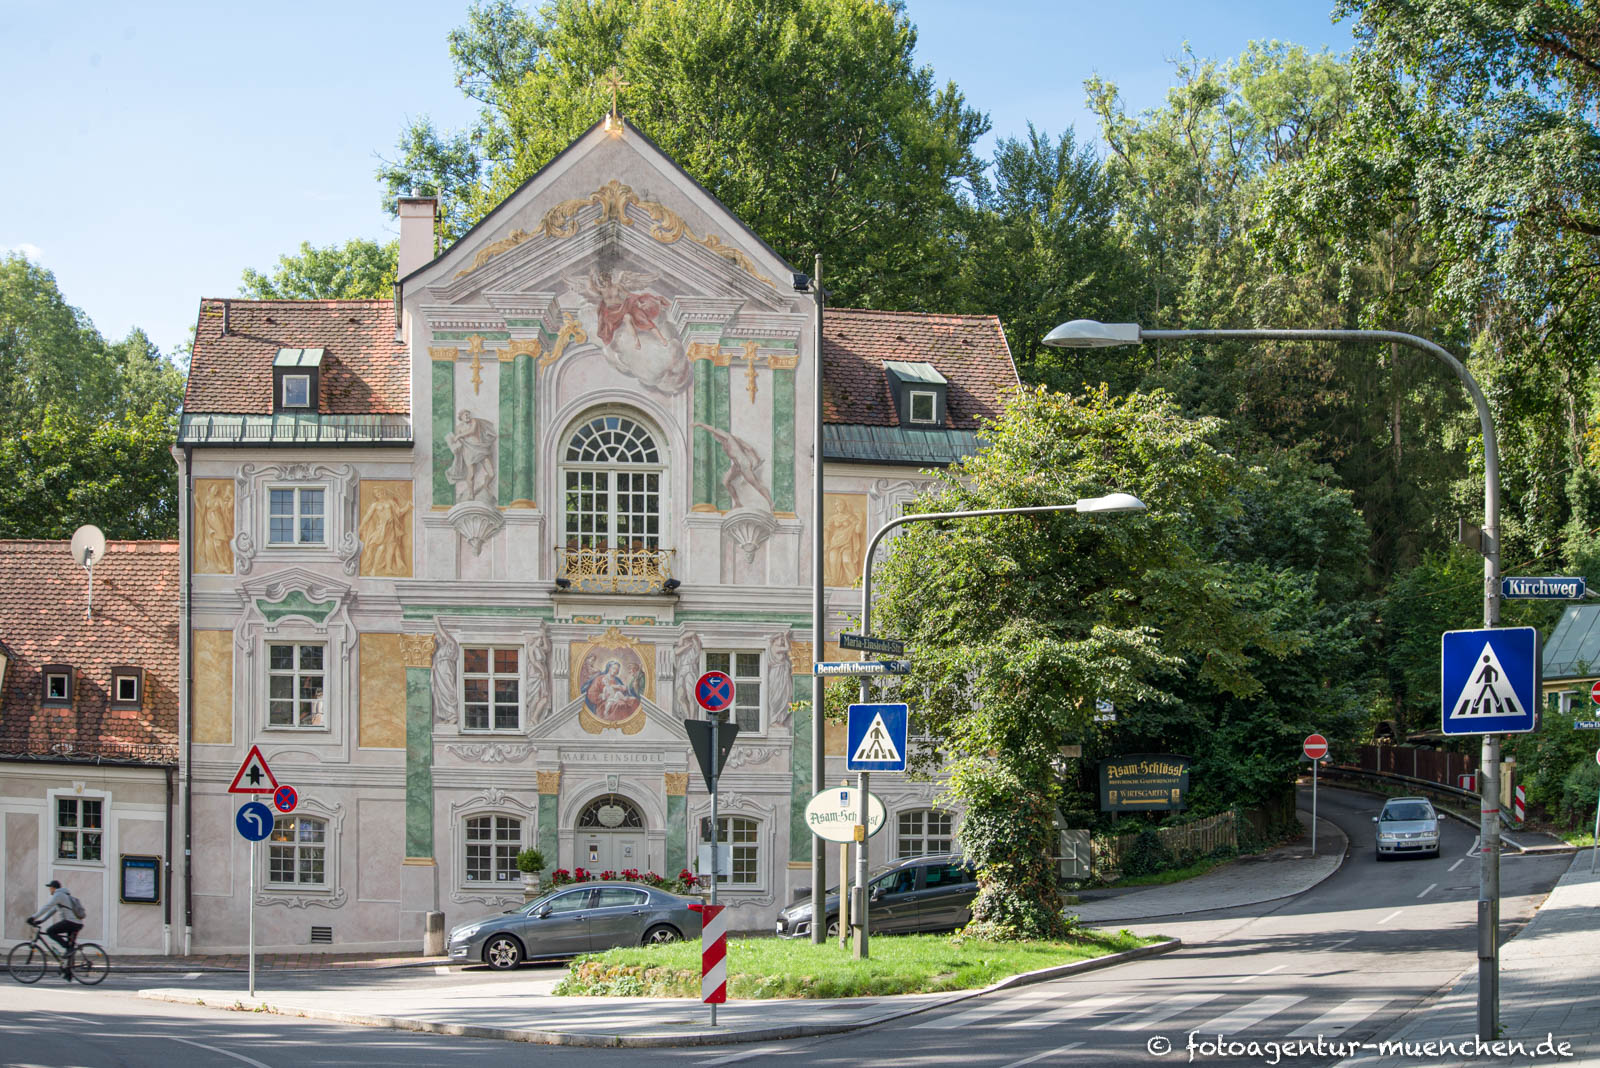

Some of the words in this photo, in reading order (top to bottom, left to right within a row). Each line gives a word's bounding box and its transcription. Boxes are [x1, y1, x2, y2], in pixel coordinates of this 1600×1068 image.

[1509, 580, 1577, 598] Kirchweg
[817, 663, 885, 674] Benediktbeurer
[562, 753, 597, 761] MARIA
[603, 753, 662, 761] EINSIEDEL
[1120, 789, 1169, 797] WIRTSGARTEN
